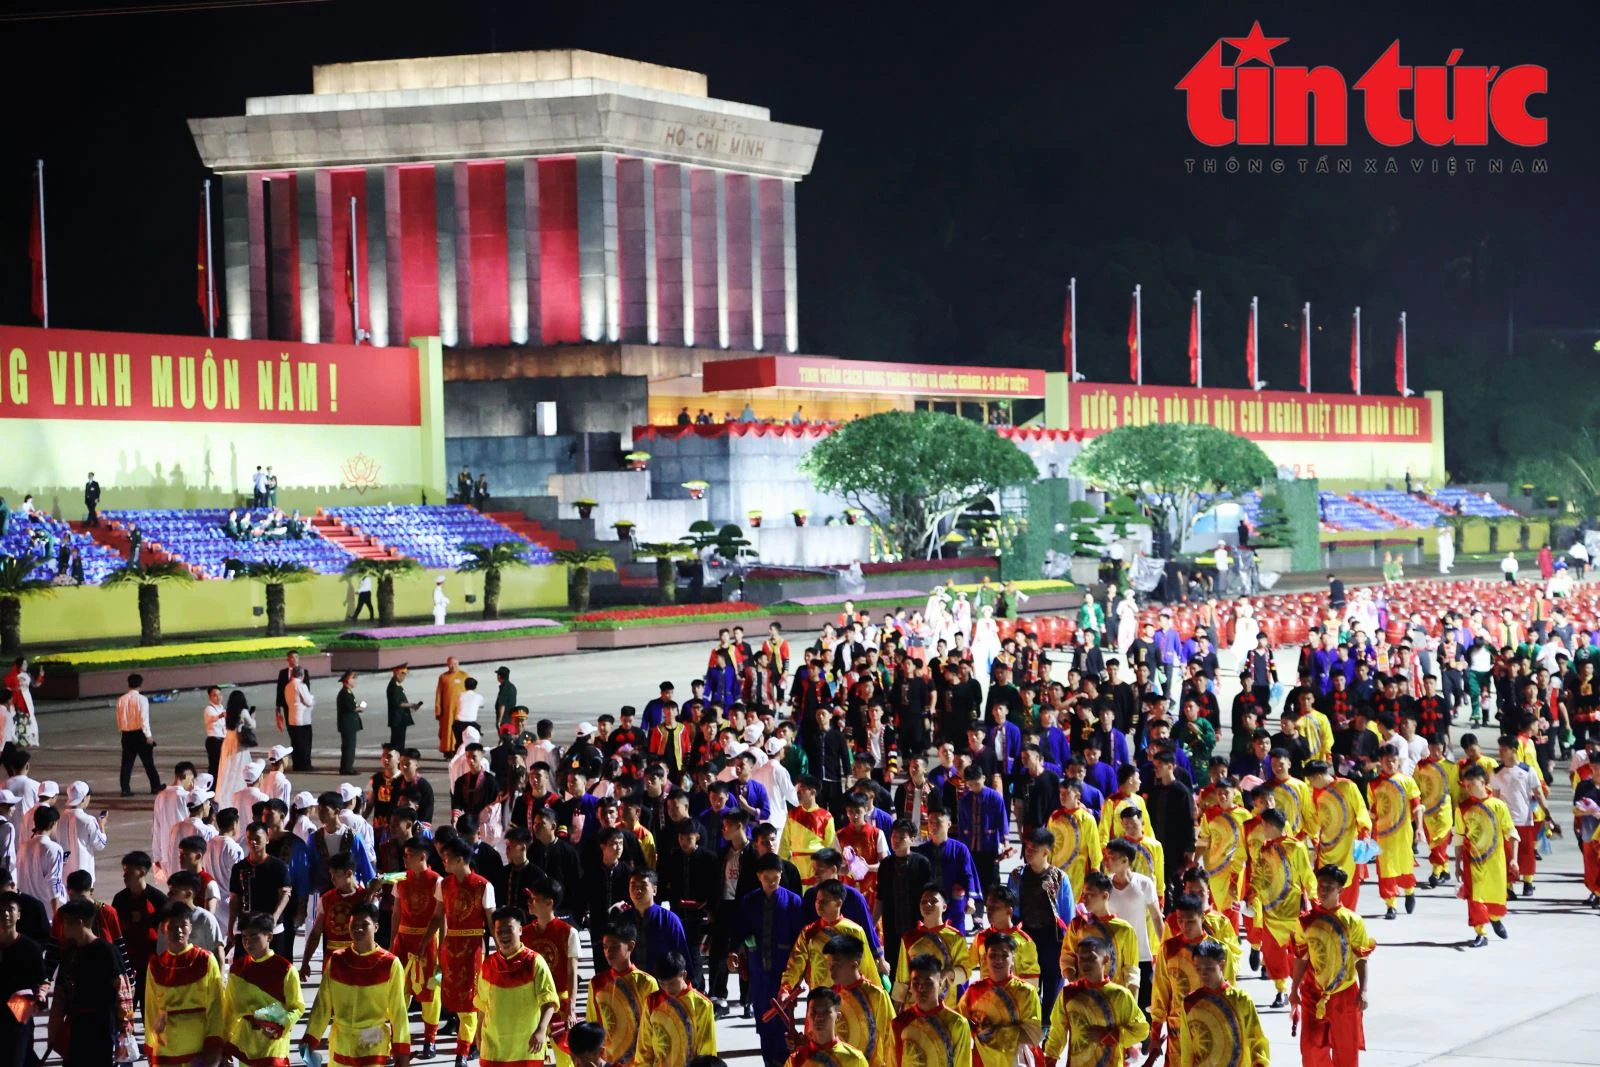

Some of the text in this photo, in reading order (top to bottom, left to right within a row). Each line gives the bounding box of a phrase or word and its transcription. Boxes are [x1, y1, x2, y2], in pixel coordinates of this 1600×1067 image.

[0, 347, 29, 405] G
[48, 350, 132, 407] VINH
[151, 348, 240, 410] MUÔN
[1081, 389, 1117, 430] NƯỚC
[1240, 393, 1264, 433] CHỦ
[1268, 397, 1303, 434] NGHĨA
[1306, 398, 1331, 440] VIỆT
[1335, 403, 1357, 434] NAM
[1361, 400, 1390, 436] MUÔN
